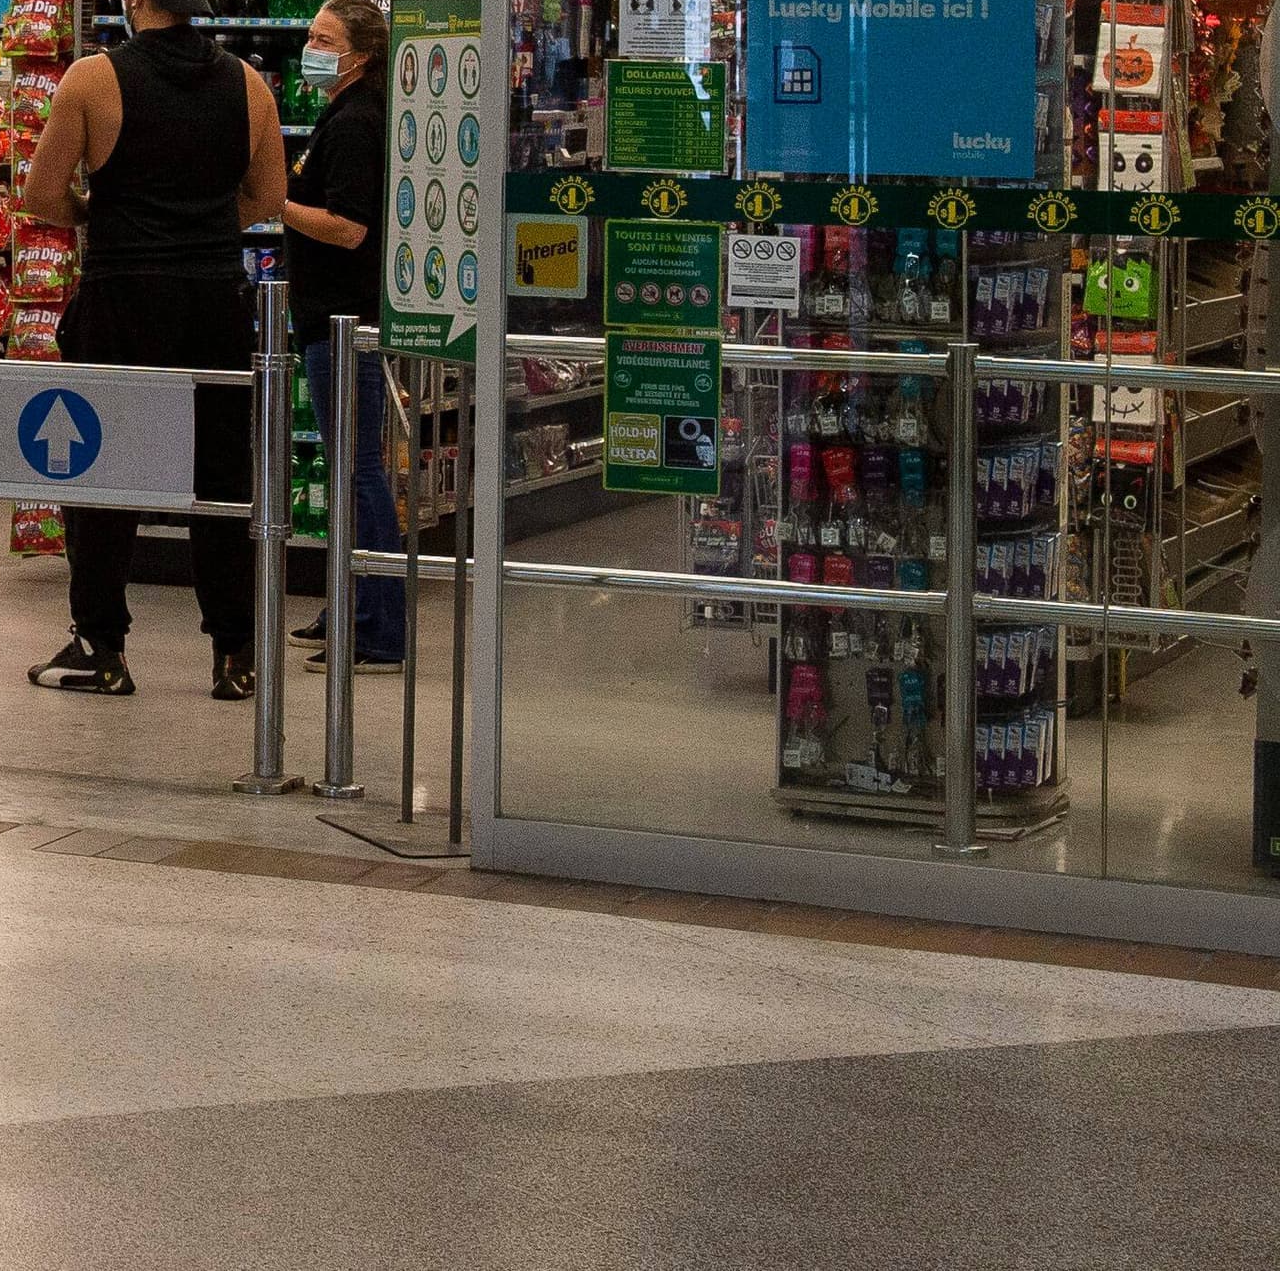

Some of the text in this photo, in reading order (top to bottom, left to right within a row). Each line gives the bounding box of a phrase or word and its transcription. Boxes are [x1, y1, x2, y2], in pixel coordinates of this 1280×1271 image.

[33, 0, 58, 18] Dip
[14, 73, 36, 88] Fun
[626, 69, 686, 80] DOLLARAMA
[615, 86, 720, 97] HEURES D'OUVERRE
[952, 131, 1012, 160] lucky mobile
[549, 176, 596, 203] DOLLARAMA
[640, 179, 688, 207] DOLLARAMA
[735, 182, 782, 210] DOLLARAMA
[830, 184, 879, 214] DOLLARAMA
[927, 187, 977, 217] DOLLARAMA
[1027, 190, 1078, 220] DOLLARAMA
[1129, 194, 1181, 224] DOLLARAMA
[614, 230, 713, 243] TOUTES LES VENTES
[17, 247, 62, 266] Fun Dip
[518, 238, 578, 261] Interac
[627, 242, 700, 254] SONT FINALES
[624, 266, 637, 274] OU
[631, 258, 658, 266] AUCUN
[15, 309, 41, 325] Fun
[622, 340, 706, 355] AVERTISSEMENT
[610, 424, 659, 440] HOLD-UP
[609, 447, 658, 461] ULTRA
